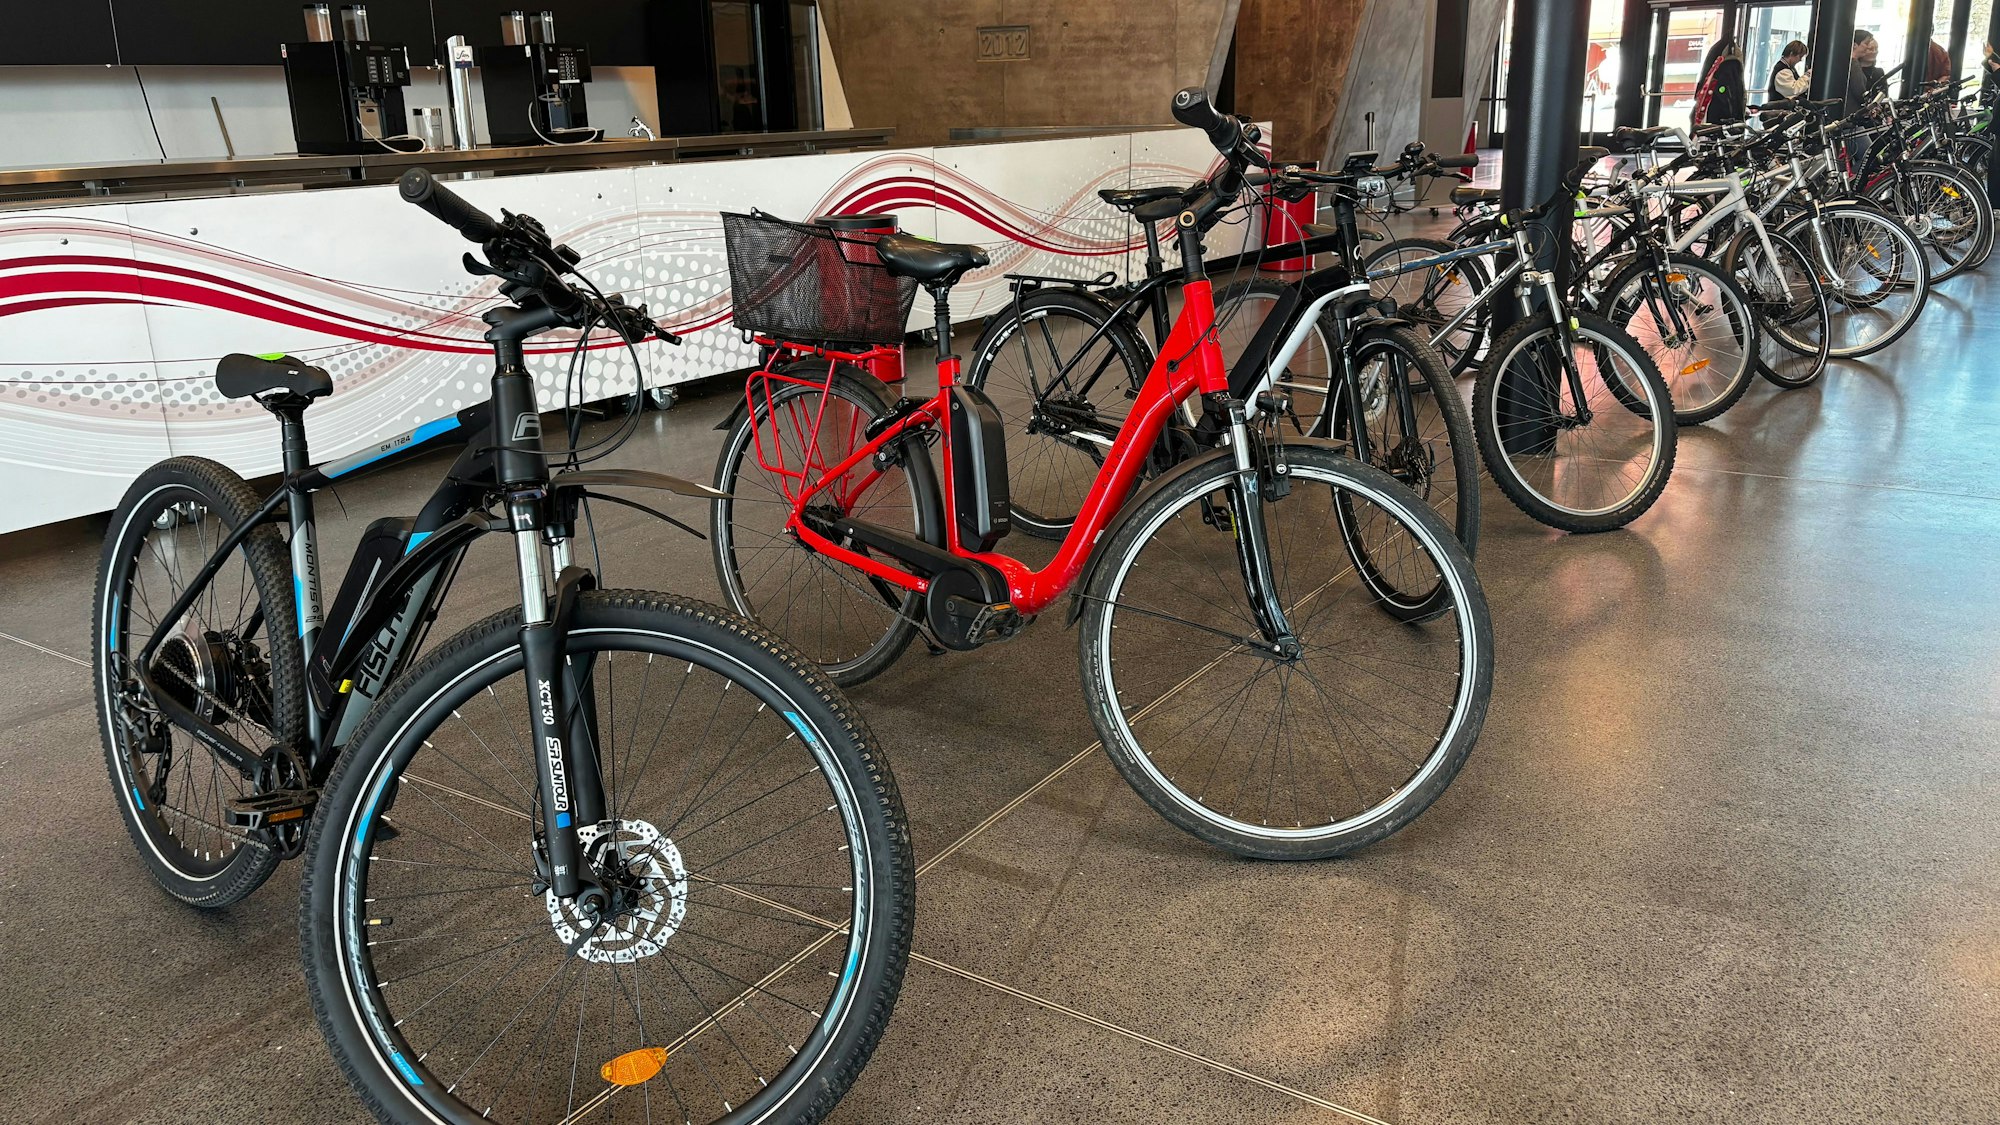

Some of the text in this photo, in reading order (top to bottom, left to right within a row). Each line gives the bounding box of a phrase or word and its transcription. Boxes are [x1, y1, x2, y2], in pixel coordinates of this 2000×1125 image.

[981, 34, 1026, 56] 2012
[380, 443, 391, 451] EM
[1102, 412, 1144, 489] KALKHOFF
[304, 542, 318, 604] MONTIS
